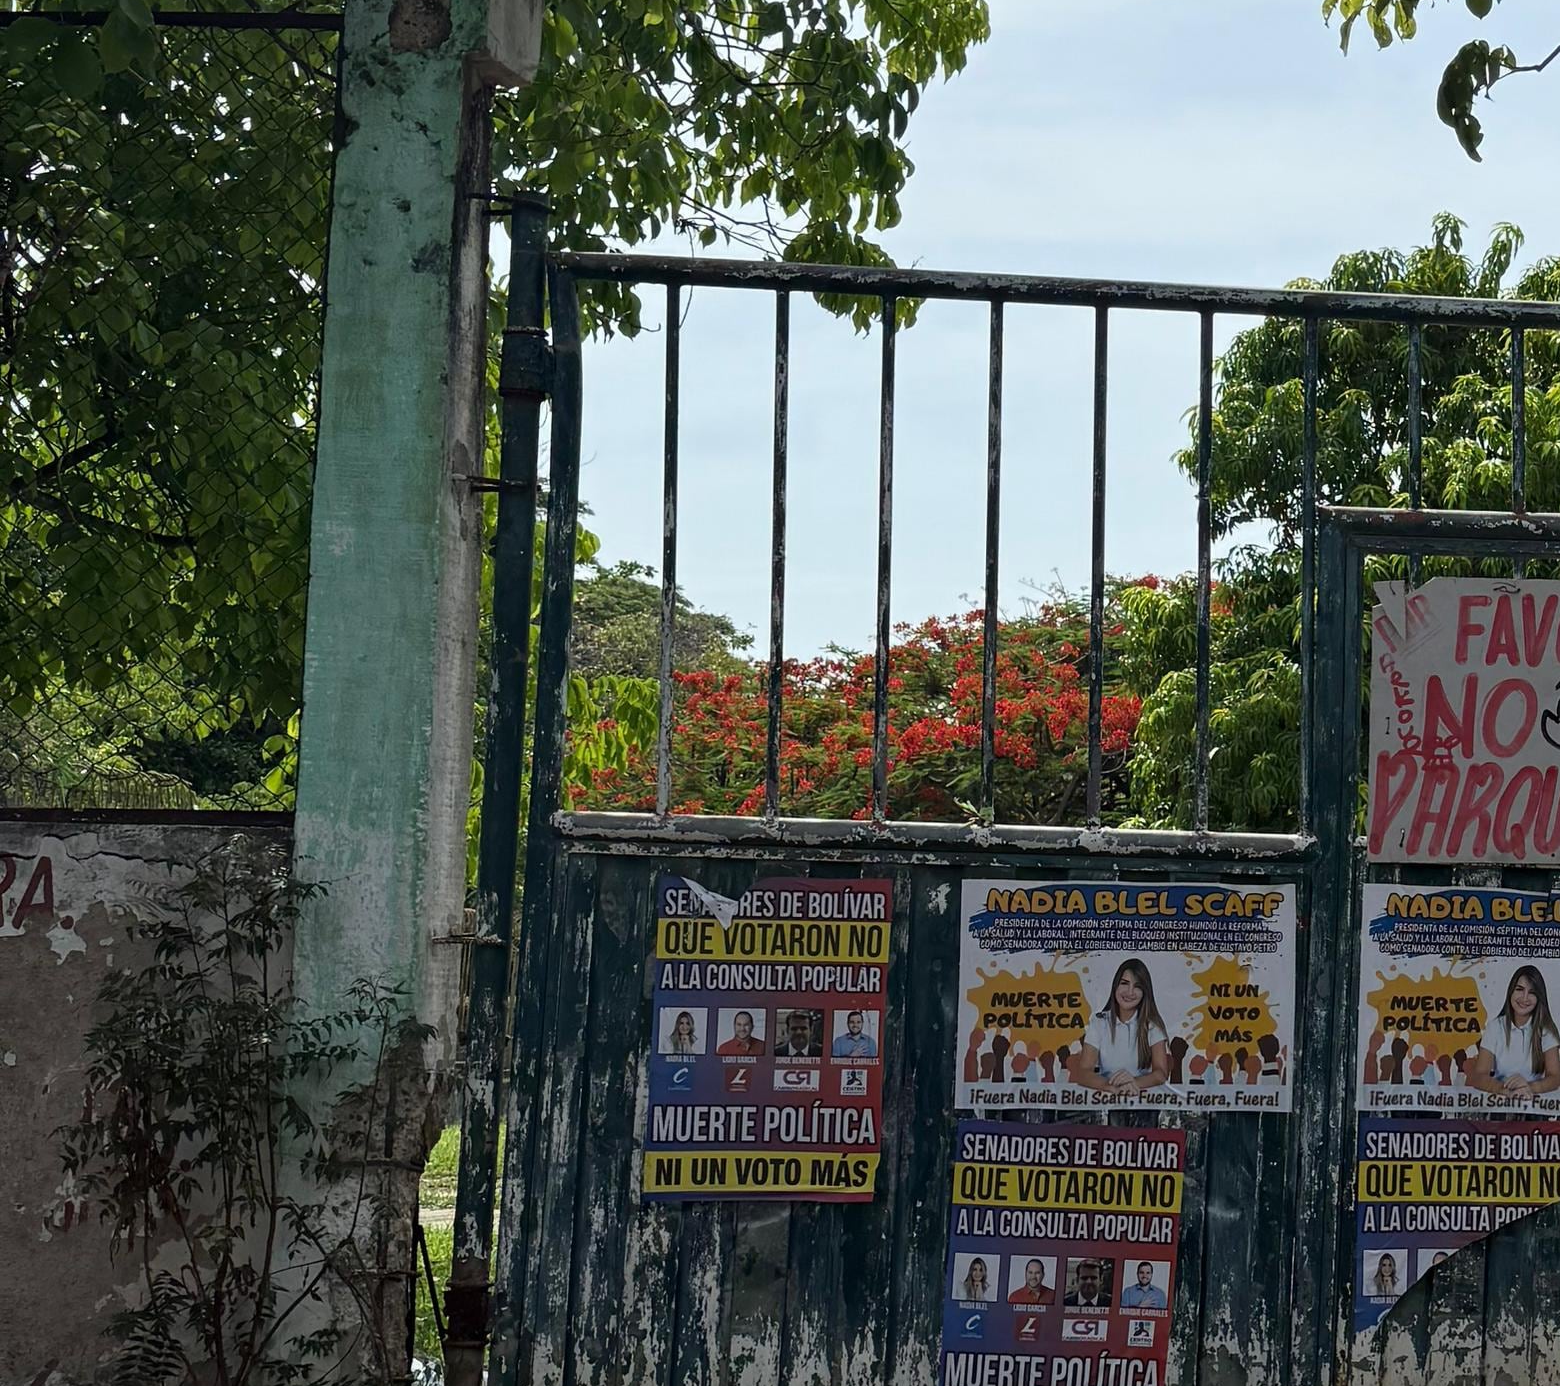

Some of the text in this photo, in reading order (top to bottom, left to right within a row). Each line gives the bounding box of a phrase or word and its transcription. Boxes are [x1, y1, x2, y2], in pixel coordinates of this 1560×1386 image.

[1423, 672, 1539, 760] NO
[664, 888, 886, 920] SENRES DE BOLÍVAR
[987, 889, 1283, 917] NADIA BLEL SCAFF
[1387, 893, 1483, 920] NADIA
[663, 921, 884, 958] QUE VOTARON NO
[973, 930, 978, 938] A
[980, 930, 989, 938] LA
[990, 929, 1014, 938] SALUD
[1016, 930, 1020, 938] Y
[1023, 930, 1031, 938] LA
[1069, 930, 1115, 939] INTEGRANTE
[1117, 931, 1130, 939] DEL
[1132, 931, 1165, 940] BLOQUEO
[1223, 932, 1233, 941] EN
[1235, 933, 1243, 941] EL
[1244, 933, 1283, 942] CONGRESO
[981, 939, 1003, 948] COMO
[1004, 940, 1042, 948] SENADORA
[1044, 940, 1073, 949] CONTRA
[1075, 940, 1083, 949] EL
[1122, 941, 1136, 950] DEL
[1138, 941, 1165, 950] CAMBIO
[1167, 941, 1177, 950] EN
[1179, 942, 1208, 951] CABEZA
[1209, 942, 1219, 951] DE
[1220, 942, 1252, 952] GUSTAVO
[1253, 943, 1277, 952] PETRO
[662, 963, 883, 993] A LA CONSULTA POPULAR
[1210, 983, 1258, 997] NI UN
[991, 991, 1082, 1009] MUERTE
[1208, 1006, 1260, 1021] VOTO
[1391, 994, 1478, 1014] MUERTE
[983, 1010, 1085, 1029] POLÍTICA
[1383, 1013, 1481, 1034] POLÍTICA
[1214, 1026, 1252, 1042] MÁS
[970, 1089, 1014, 1105] ¡Fuera
[1019, 1089, 1058, 1105] Nadia
[1062, 1089, 1088, 1105] Blel
[1138, 1090, 1182, 1107] Fuera,
[1186, 1091, 1230, 1107] Fuera,
[1235, 1091, 1279, 1107] Fuera!
[1370, 1089, 1413, 1107] ¡Fuera
[1417, 1090, 1454, 1107] Nadia
[1458, 1092, 1483, 1109] Blel
[652, 1100, 877, 1143] MUERTE POLÍTICA
[961, 1134, 1180, 1169] SENADORES DE BOLÍVAR
[1365, 1132, 1470, 1159] SENADORES
[1474, 1135, 1496, 1159] DE
[655, 1153, 869, 1188] NI UN VOTO MÁS
[1365, 1164, 1413, 1198] QUE
[1419, 1164, 1531, 1197] VOTARON
[959, 1166, 1176, 1208] QUE VOTARON NO
[957, 1209, 1173, 1243] A LA CONSULTA POPULAR
[1364, 1206, 1376, 1231] A
[1380, 1206, 1401, 1231] LA
[1406, 1206, 1490, 1231] CONSULTA
